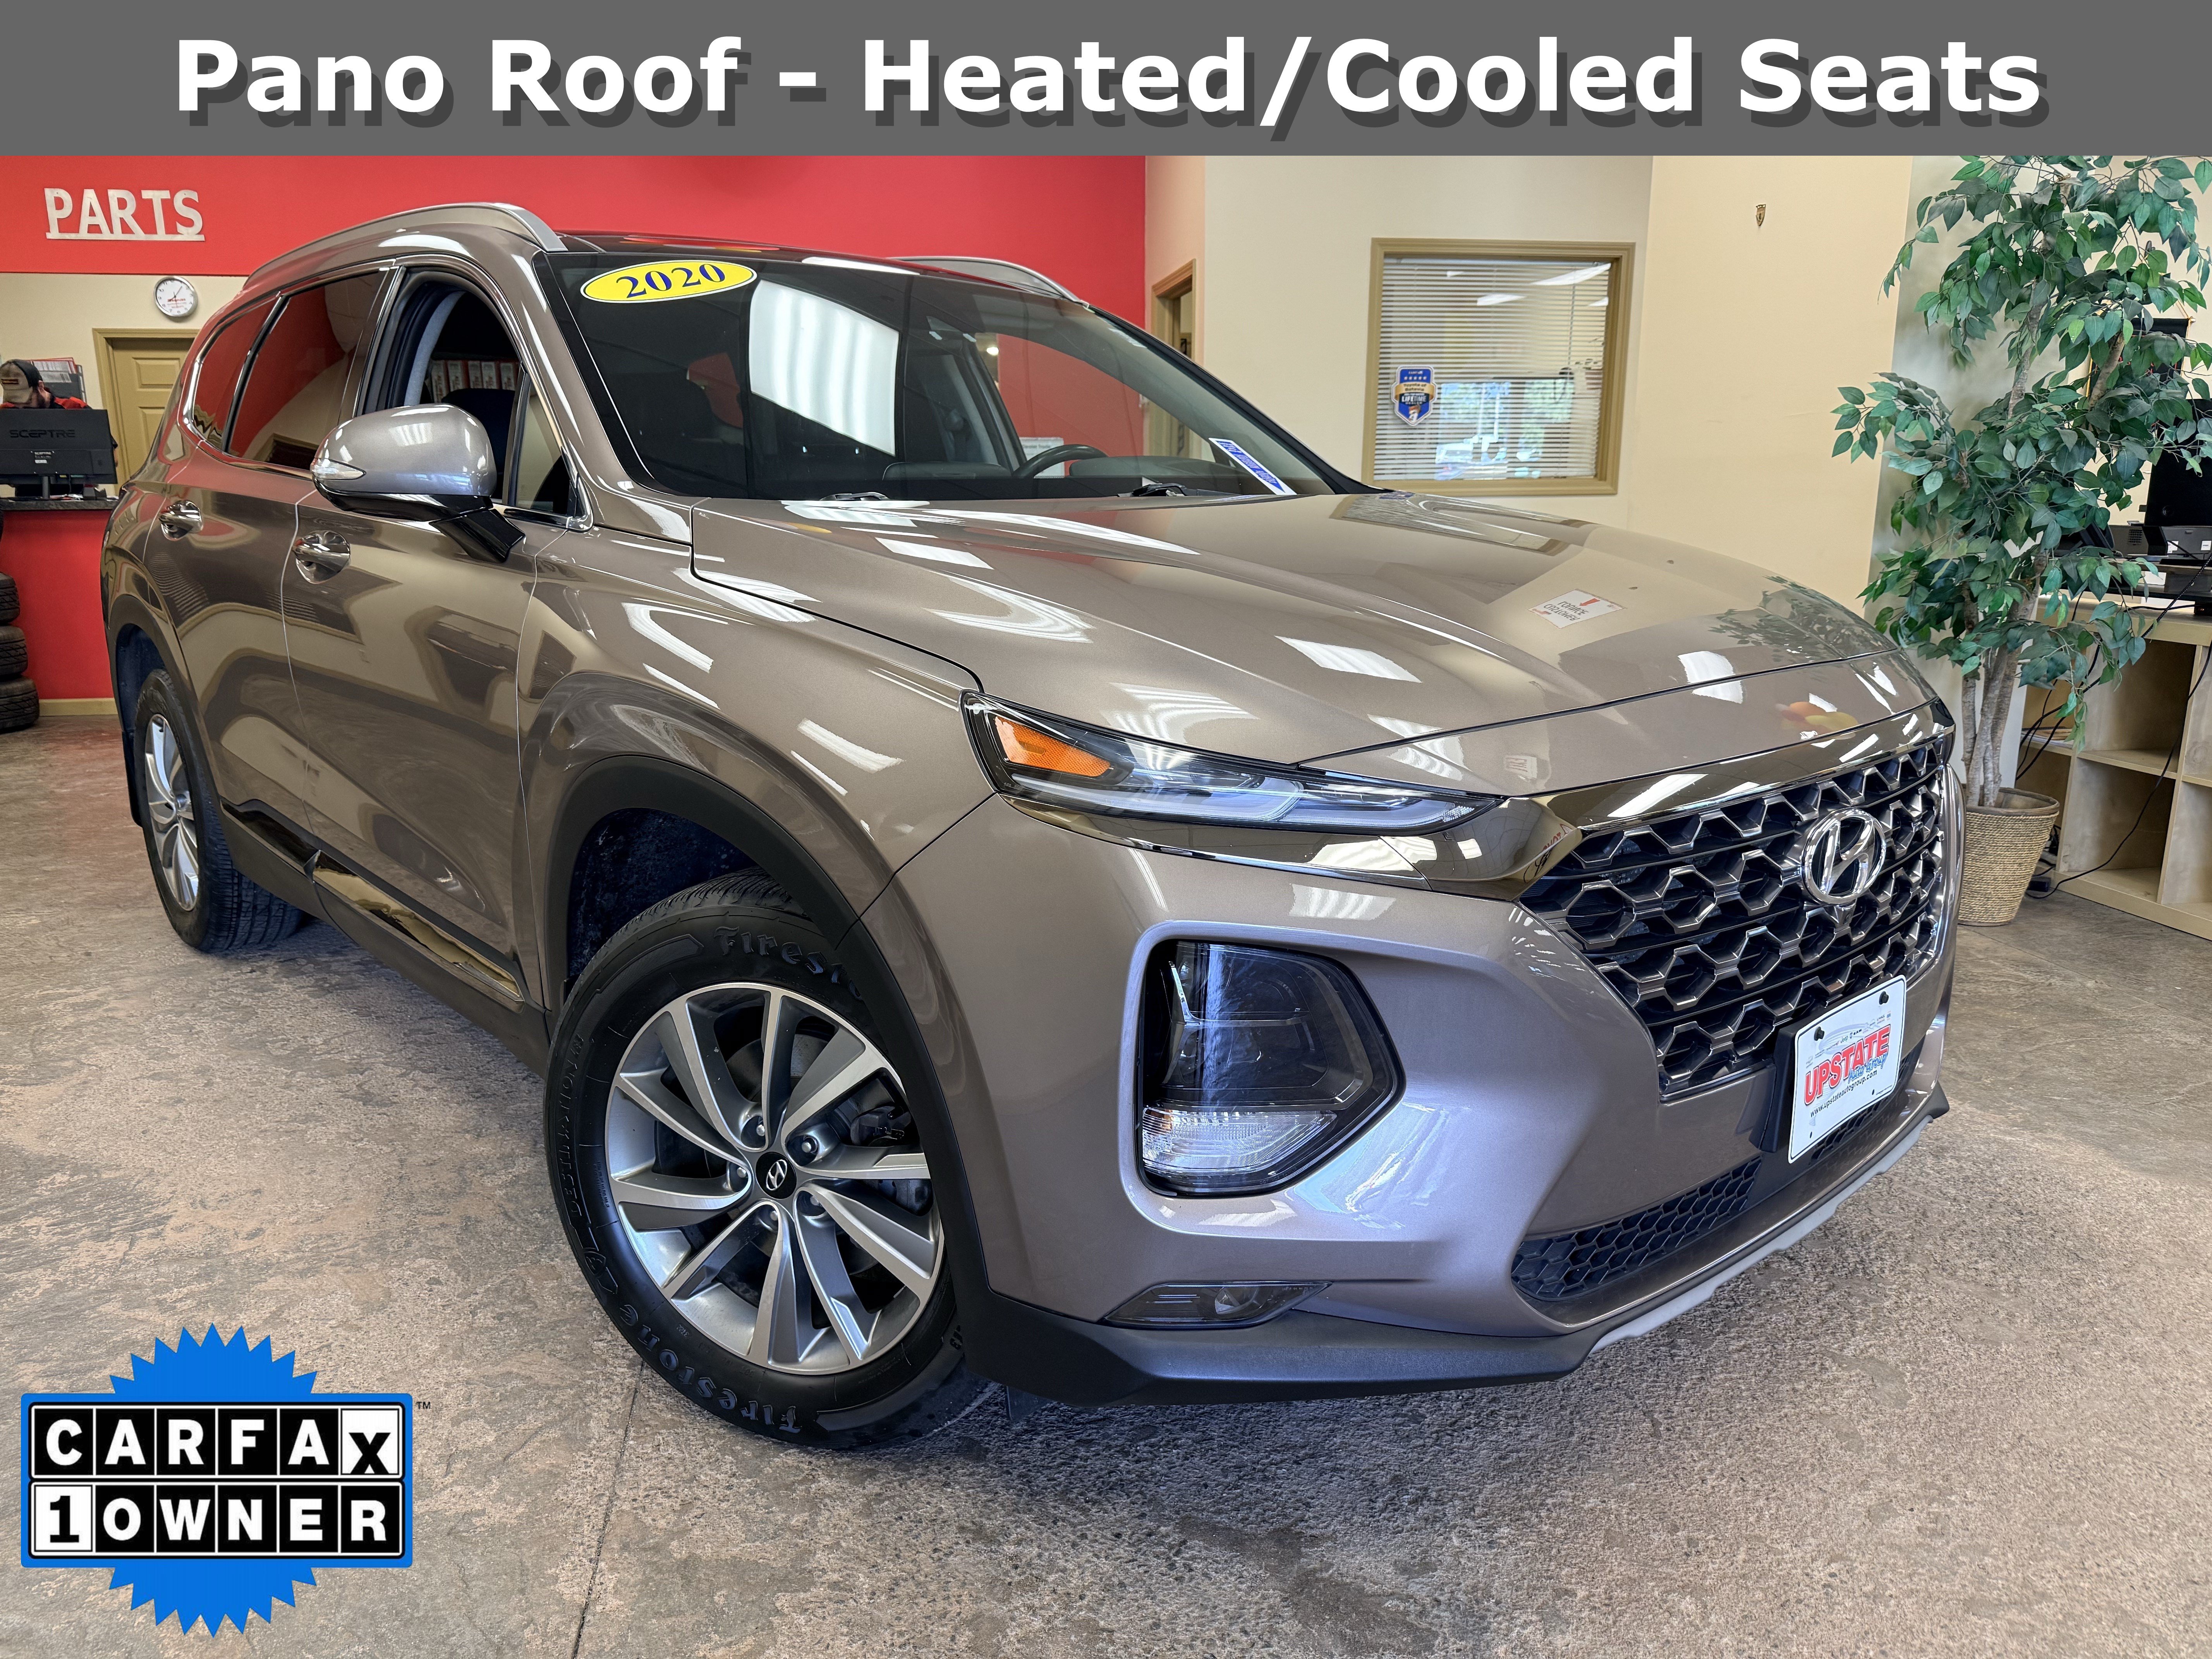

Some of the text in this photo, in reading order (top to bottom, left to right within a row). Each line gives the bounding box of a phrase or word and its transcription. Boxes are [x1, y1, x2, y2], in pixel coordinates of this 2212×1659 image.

[44, 187, 204, 238] PARTS
[616, 264, 725, 298] 2020
[9, 429, 76, 438] SCEPTRE
[714, 926, 863, 1001] Firesto
[1804, 1024, 1891, 1106] UPSTATE
[1848, 1065, 1864, 1084] Auto
[1810, 1070, 1877, 1118] www.upstateautogroup.com
[619, 1304, 803, 1434] Firestone
